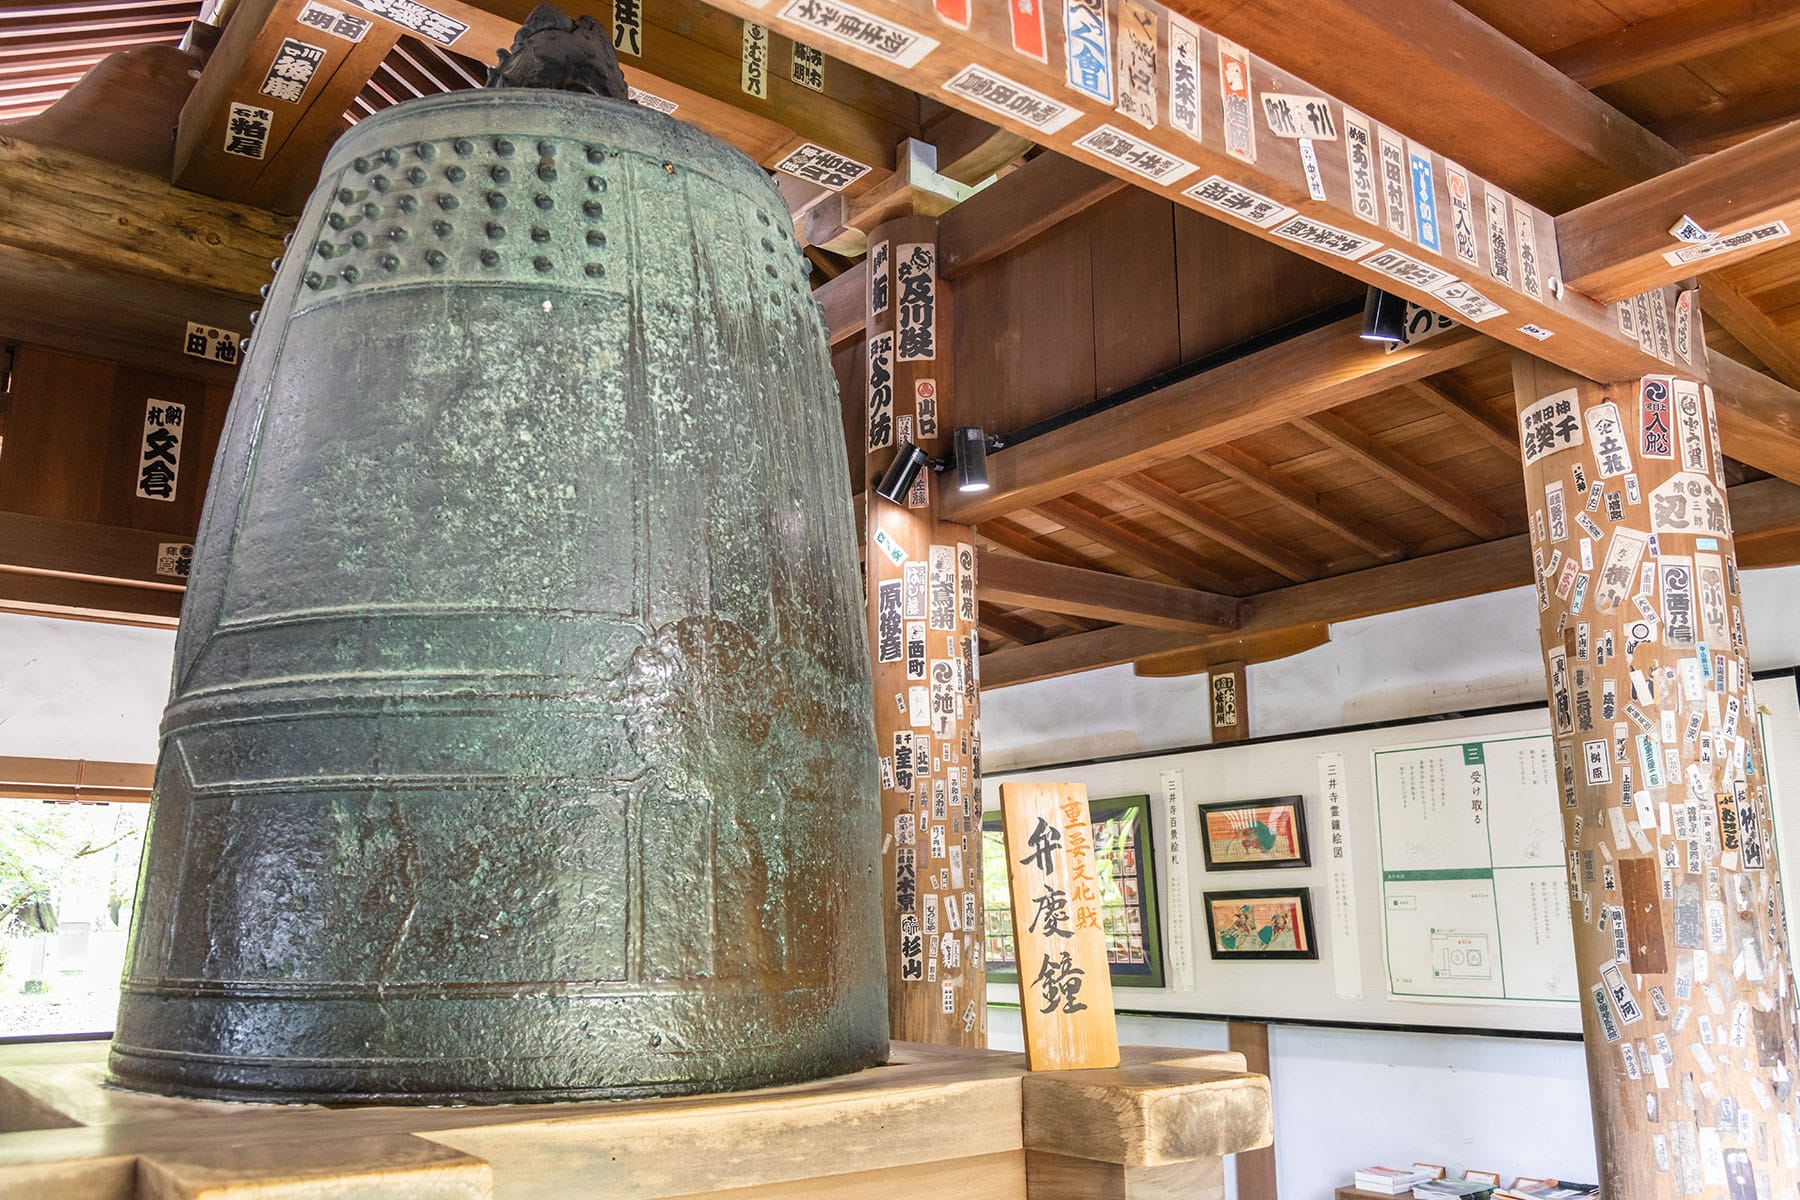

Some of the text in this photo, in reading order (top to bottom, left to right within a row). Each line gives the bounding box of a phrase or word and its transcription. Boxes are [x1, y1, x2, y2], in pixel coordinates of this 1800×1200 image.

[262, 55, 313, 101] 後藤
[918, 398, 937, 436] 山口
[139, 428, 179, 498] 文倉
[1468, 748, 1480, 760] 三
[1470, 771, 1484, 824] 受け取る
[1060, 796, 1101, 930] 重要文化財
[1019, 816, 1088, 1015] 弁慶鐘
[902, 935, 923, 980] 杉山
